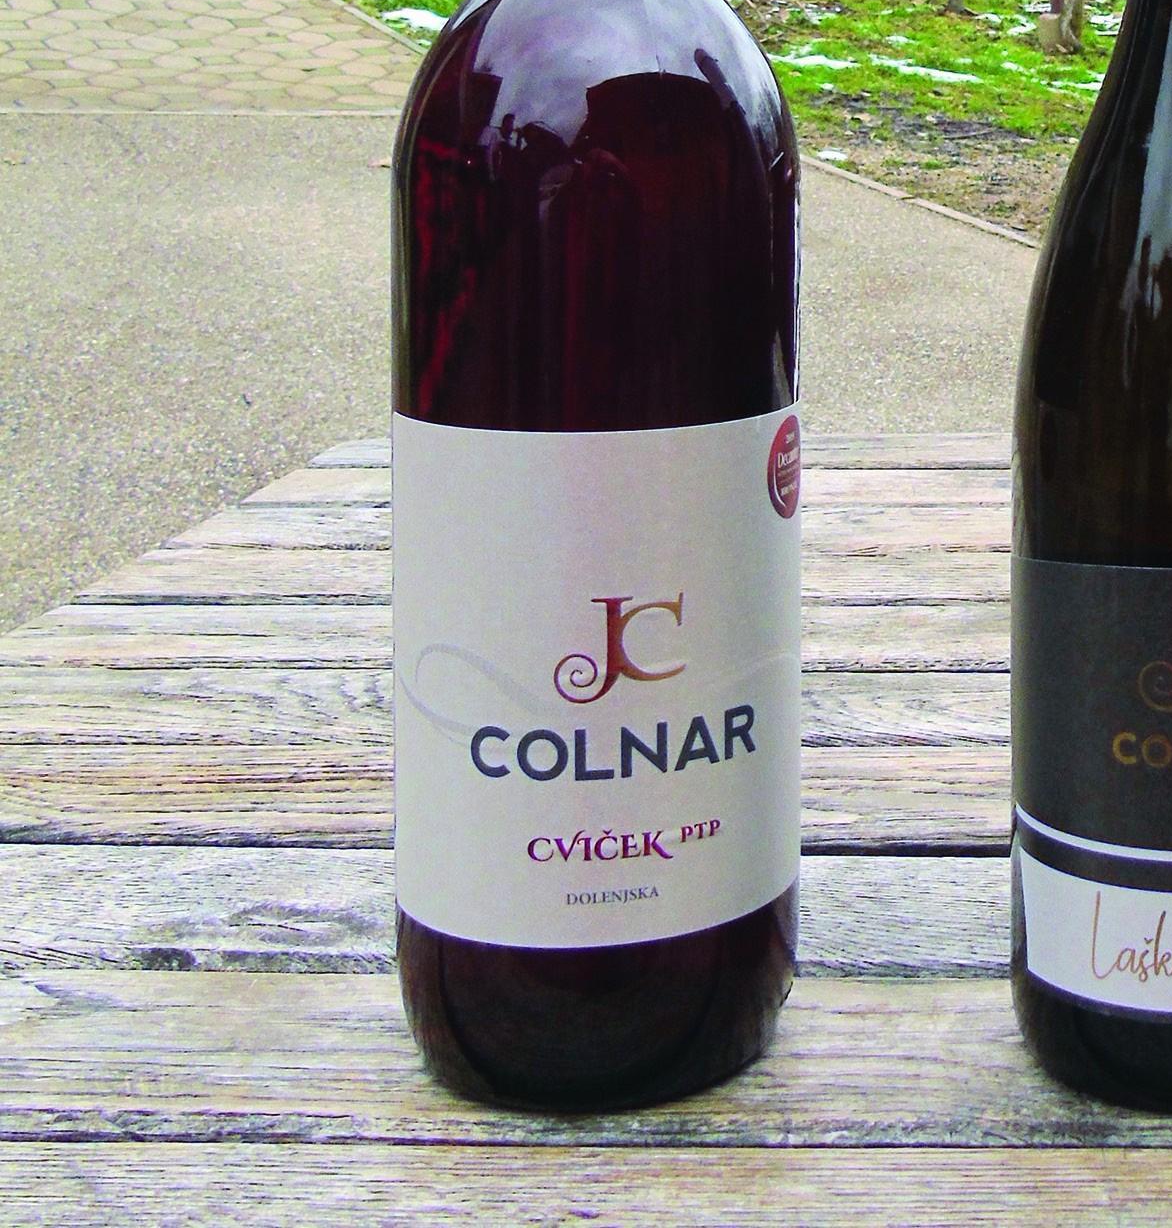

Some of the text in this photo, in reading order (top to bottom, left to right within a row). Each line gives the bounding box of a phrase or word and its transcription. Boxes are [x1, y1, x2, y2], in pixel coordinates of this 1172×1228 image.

[470, 704, 757, 782] COLNAR
[527, 819, 721, 864] CVIČEK PTP
[566, 886, 659, 907] DOLENJSKA
